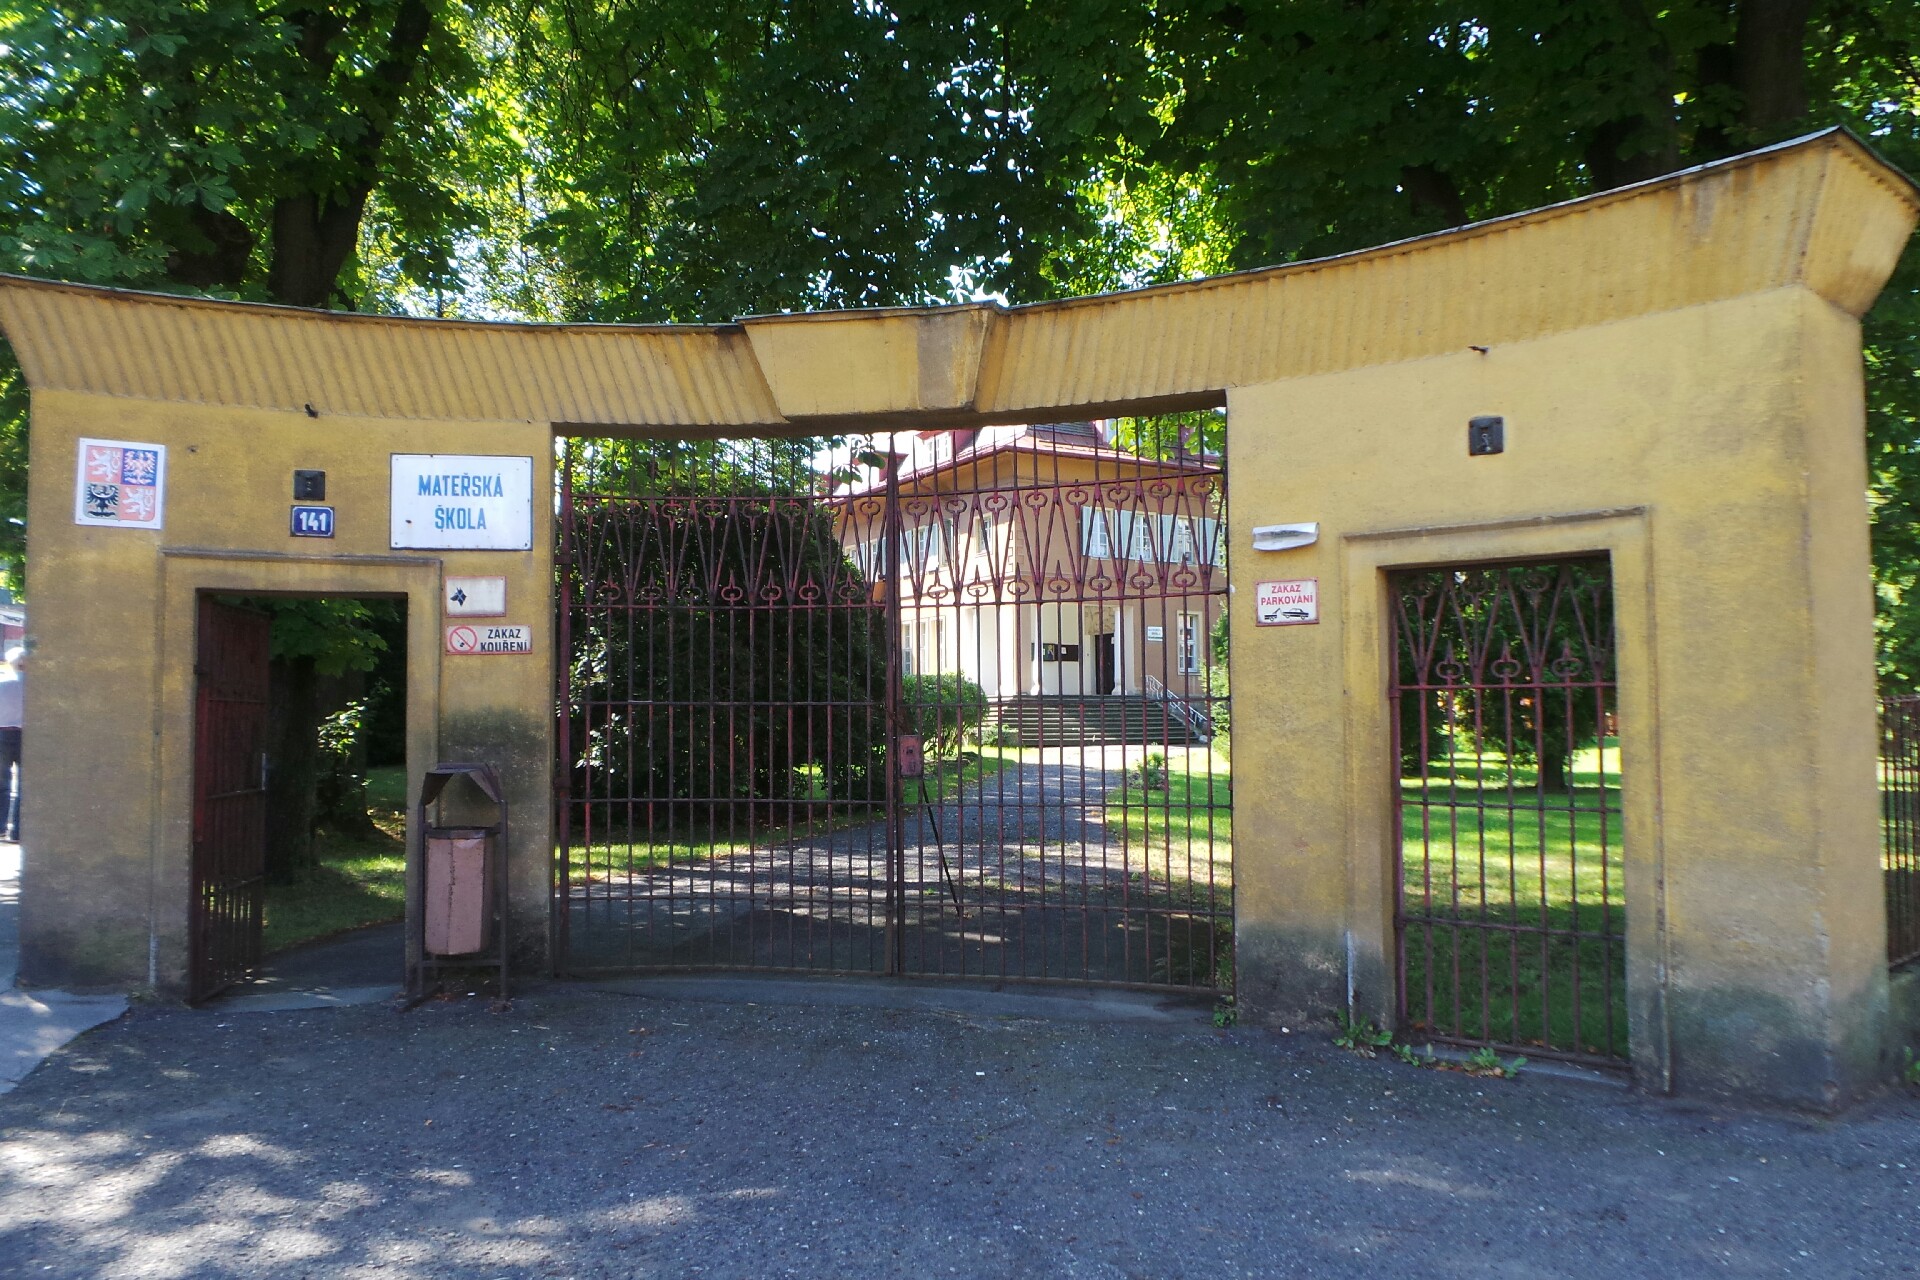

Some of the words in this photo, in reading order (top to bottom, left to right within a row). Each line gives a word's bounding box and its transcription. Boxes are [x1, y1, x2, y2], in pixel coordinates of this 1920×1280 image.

[417, 472, 504, 498] MATEŘSKÁ
[299, 511, 327, 532] 141
[435, 504, 487, 530] ŠKOLA
[488, 626, 522, 640] ZÁKAZ
[480, 639, 527, 652] KOUŘENÍ
